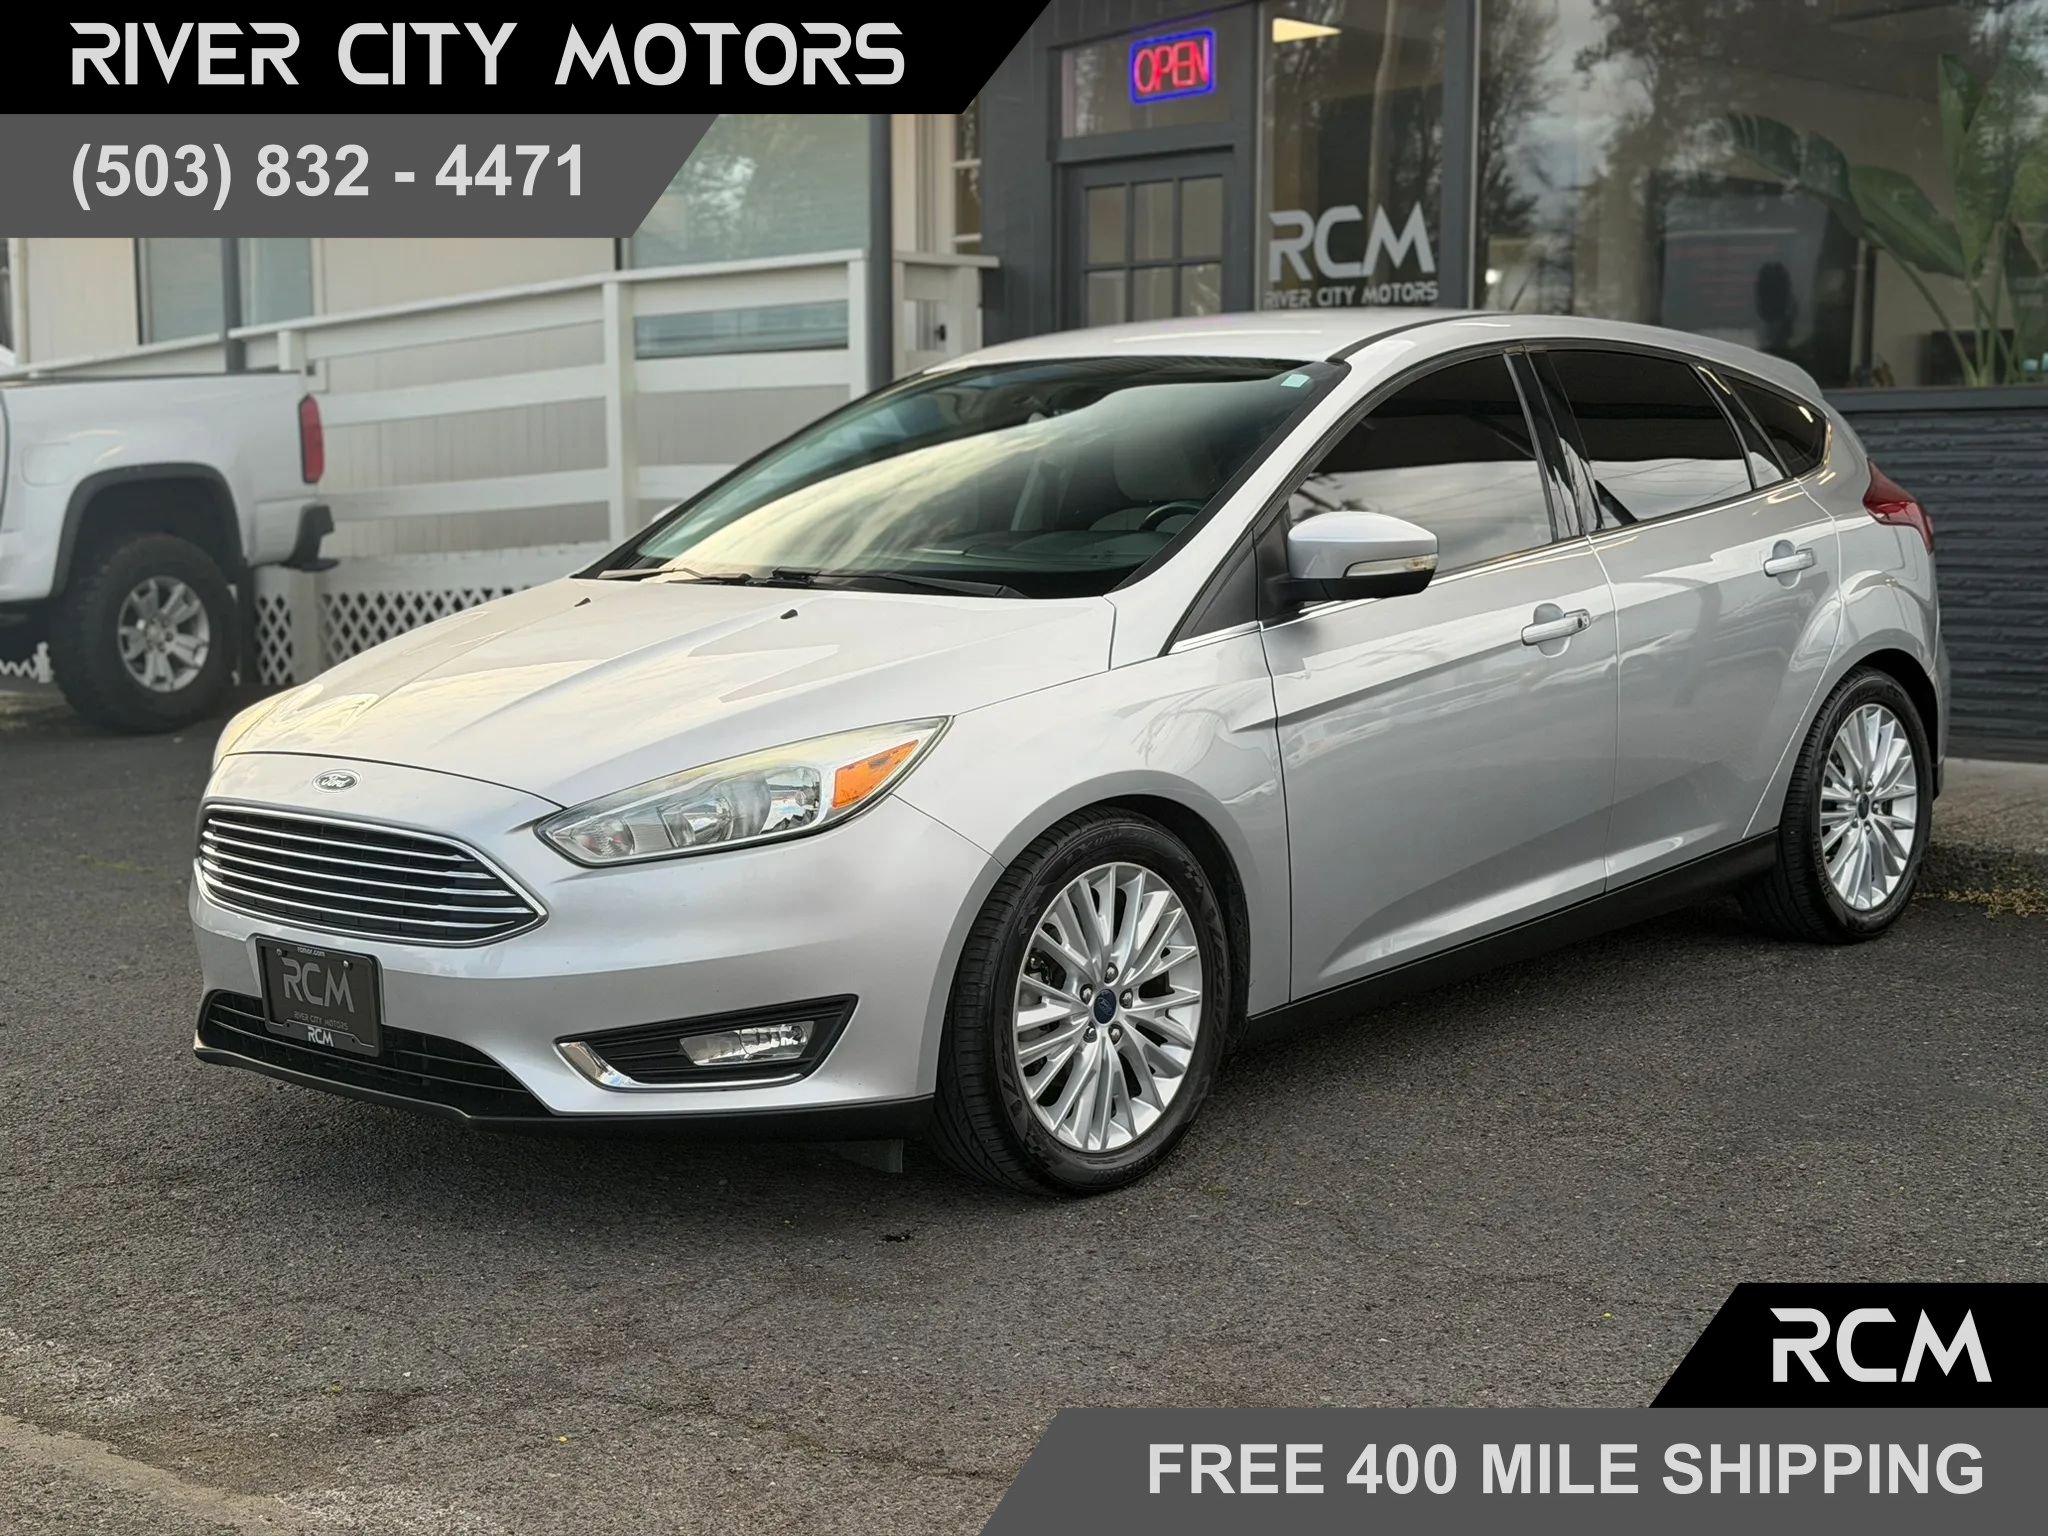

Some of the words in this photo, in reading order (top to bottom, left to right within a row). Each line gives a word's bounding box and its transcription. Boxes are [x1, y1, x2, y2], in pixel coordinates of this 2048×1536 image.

[1134, 35, 1210, 94] OPEN
[1268, 201, 1436, 283] RCM
[1264, 289, 1312, 308] RIVER
[1316, 285, 1357, 306] CITY
[1361, 281, 1439, 304] MOTORS
[281, 956, 355, 1013] RCM
[307, 1025, 334, 1047] RCM
